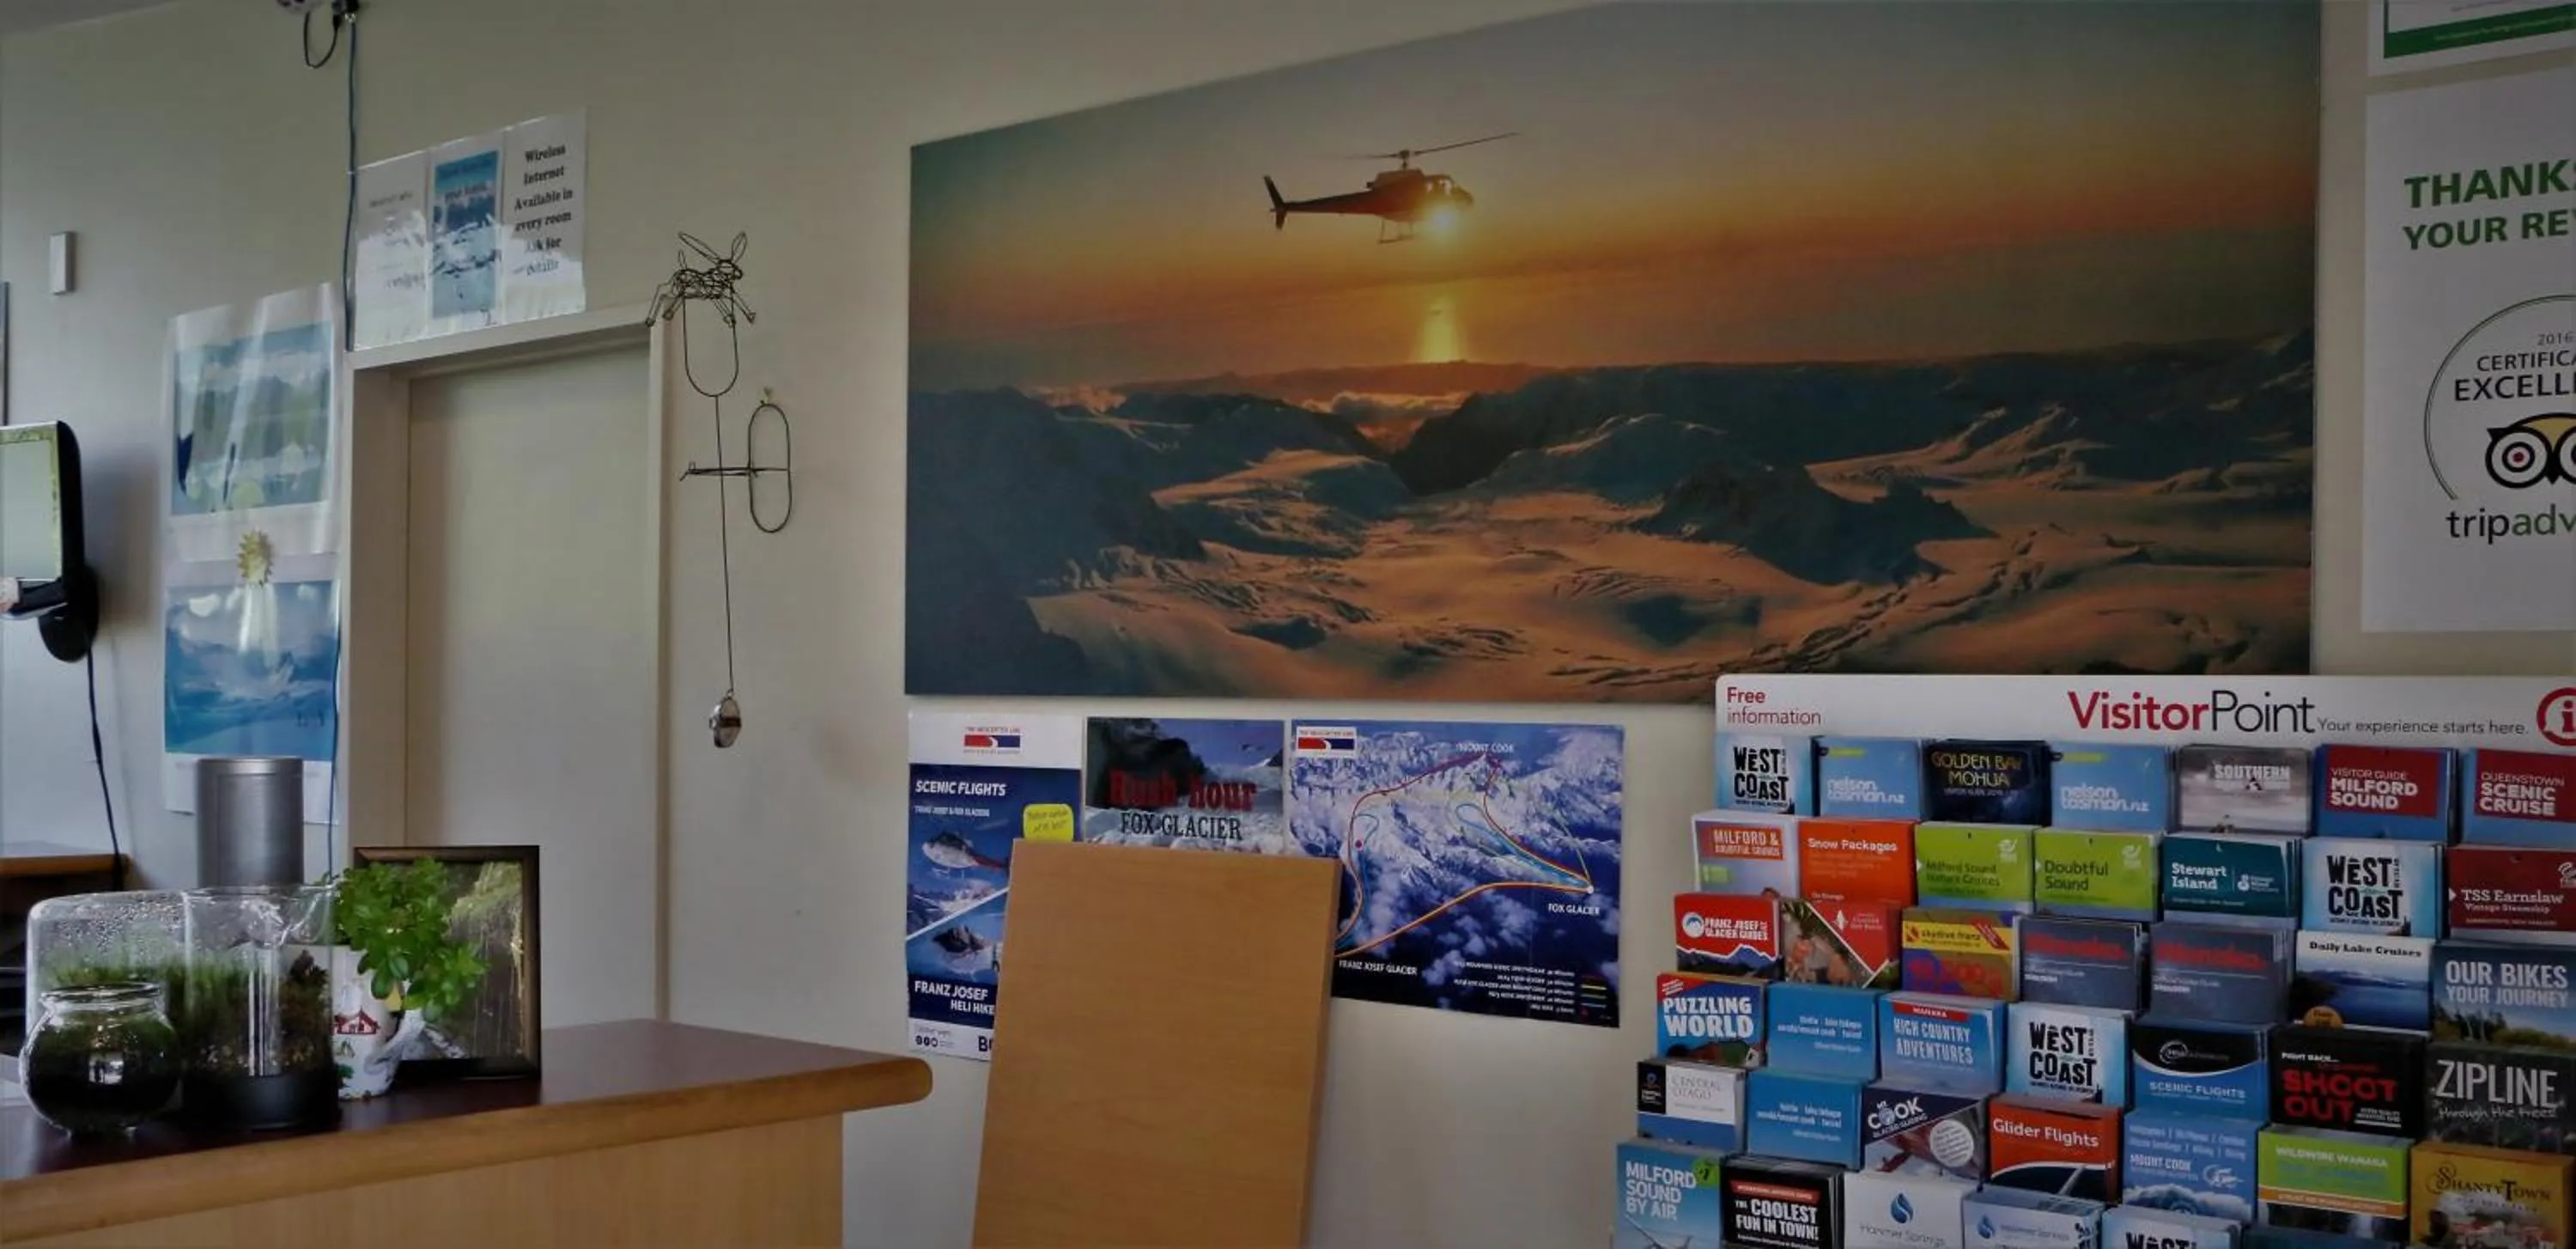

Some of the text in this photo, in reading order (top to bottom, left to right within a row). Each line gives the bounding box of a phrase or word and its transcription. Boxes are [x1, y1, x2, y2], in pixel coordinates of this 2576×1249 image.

[526, 143, 566, 163] Wireless
[524, 166, 565, 186] Internet
[2403, 157, 2576, 209] THANK
[515, 188, 573, 211] Available in
[515, 212, 572, 233] every room
[2403, 209, 2576, 251] YOUR RE
[2454, 371, 2576, 401] EXCELL
[1727, 687, 1766, 704] Free
[1727, 707, 1821, 725] information
[2068, 691, 2316, 734] VisitorPoint
[2318, 717, 2529, 736] Your experience starts here.
[1734, 746, 1781, 774] WEST
[1931, 751, 1990, 770] GOLDEN
[1948, 771, 2010, 788] MOHUA
[2214, 764, 2290, 780] SOUTHERN
[2330, 768, 2407, 780] VISITOR GUIDE
[2481, 771, 2565, 787] QUEENSTOWN
[915, 780, 1007, 796] SCENIC FLIGHTS
[1734, 773, 1789, 801] COAST
[2330, 778, 2418, 796] MILFORD
[2481, 783, 2555, 801] SCENIC
[2330, 793, 2398, 810] SOUND
[2480, 798, 2555, 816] CRUISE
[1121, 812, 1242, 840] FOX GLACIER
[1714, 830, 1780, 846] MILFORD &
[1808, 838, 1899, 855] Snow Packages
[2044, 860, 2108, 876] Doubtful
[2172, 862, 2227, 877] Stewart
[2326, 856, 2392, 887] WEST
[2044, 875, 2089, 891] Sound
[2172, 875, 2218, 890] Island
[2328, 886, 2403, 919] COAST
[2461, 889, 2565, 904] TSS Earnslaw
[1548, 904, 1600, 915] FOX GLACIER
[2309, 941, 2422, 957] Daily Lake Cruises
[1386, 964, 1417, 975] GLACIER
[2445, 960, 2567, 989] OUR BIKES
[914, 980, 988, 1002] FRANZ JOSEF
[2445, 986, 2567, 1008] YOUR JOURNEY
[951, 999, 971, 1011] HELI
[1663, 996, 1753, 1014] PUZZLING
[1663, 1014, 1754, 1039] WORLD
[1893, 1017, 1971, 1043] HIGH COUNTRY
[2029, 1021, 2087, 1056] WEST
[1896, 1038, 1973, 1065] ADVENTURES
[2029, 1051, 2097, 1087] COAST
[2150, 1081, 2245, 1099] SCENIC FLIGHTS
[2282, 1069, 2397, 1101] SHOOT
[2436, 1059, 2559, 1108] ZIPLINE
[2285, 1095, 2354, 1123] OUT
[2439, 1106, 2488, 1121] through
[2491, 1106, 2514, 1117] the
[1993, 1118, 2099, 1148] Glider Flights
[1625, 1161, 1697, 1189] MILFORD
[1625, 1179, 1682, 1203] SOUND
[1625, 1197, 1677, 1222] BY AIR
[1751, 1198, 1818, 1224] COOLEST
[1735, 1214, 1762, 1232] FUN
[1763, 1219, 1777, 1234] IN
[1779, 1220, 1820, 1241] TOWN!
